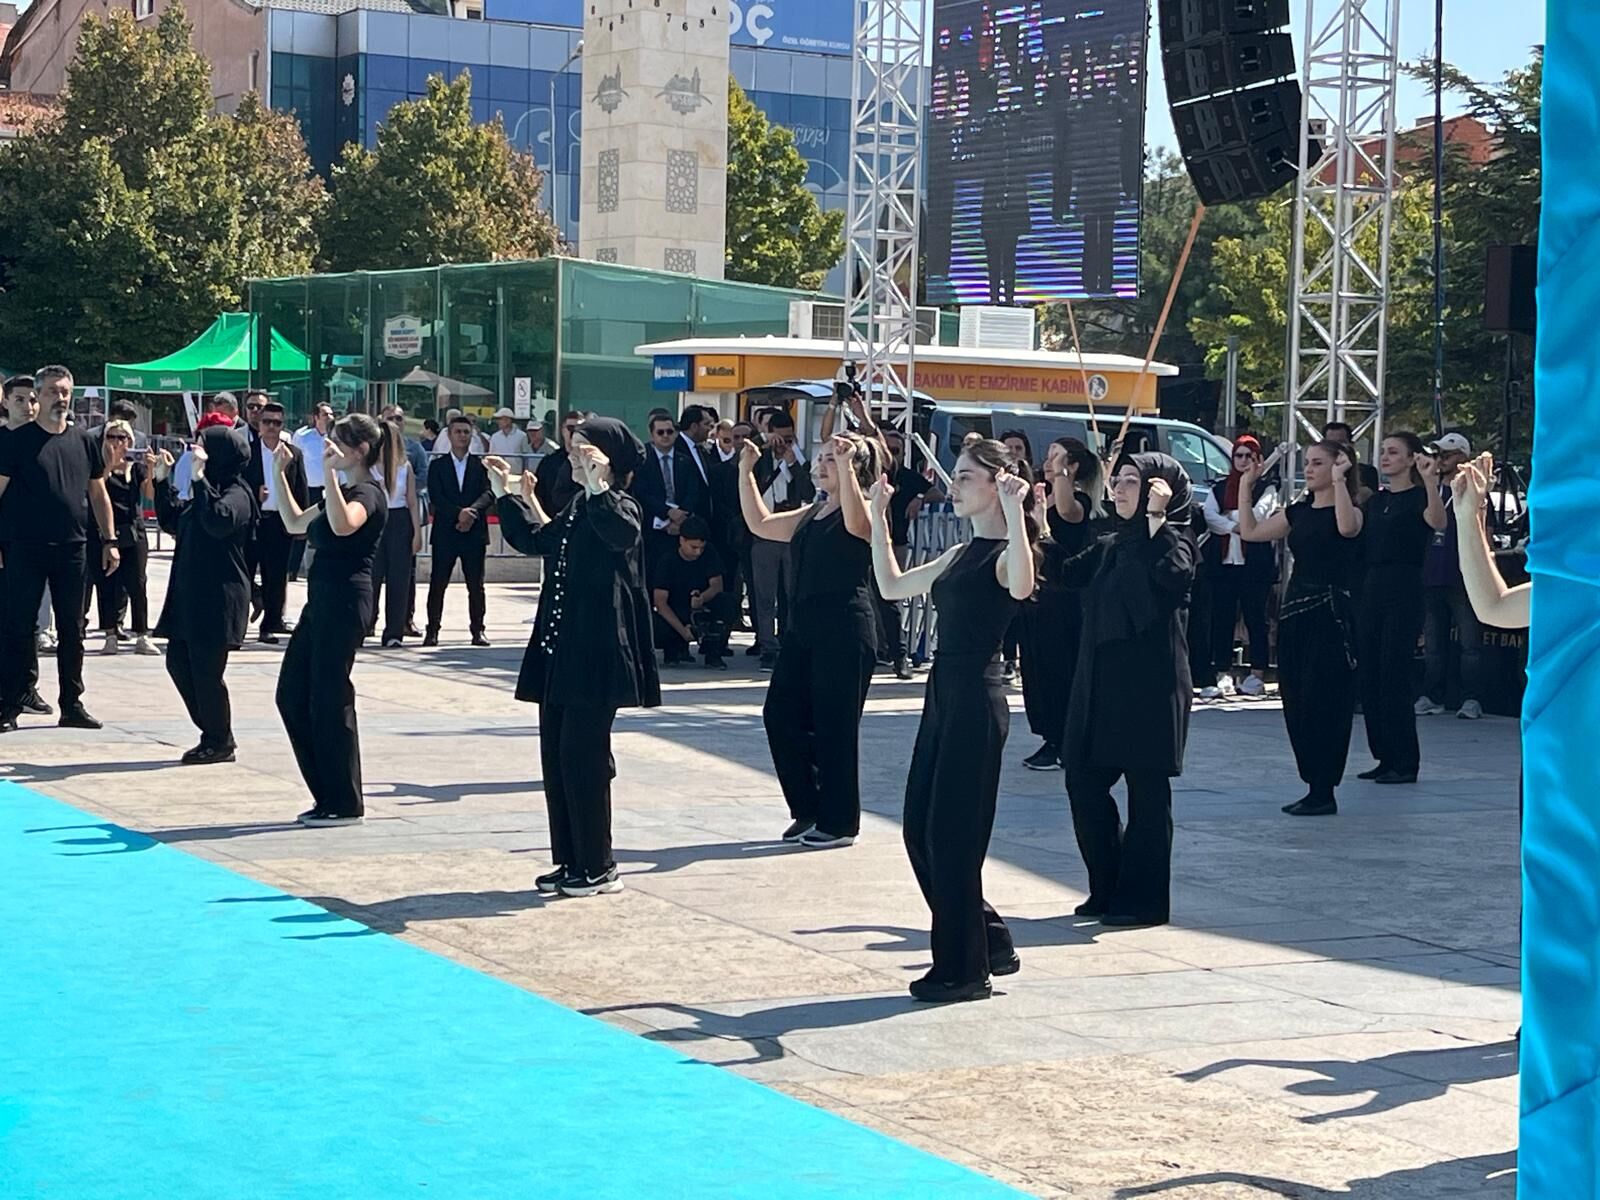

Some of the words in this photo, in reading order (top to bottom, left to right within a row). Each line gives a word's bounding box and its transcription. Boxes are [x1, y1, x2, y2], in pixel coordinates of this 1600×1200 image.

[666, 13, 672, 23] 7
[699, 18, 705, 28] 5
[682, 22, 688, 32] 6
[914, 373, 955, 388] BAKIM
[959, 375, 976, 389] VE
[979, 374, 1038, 392] EMZİRME
